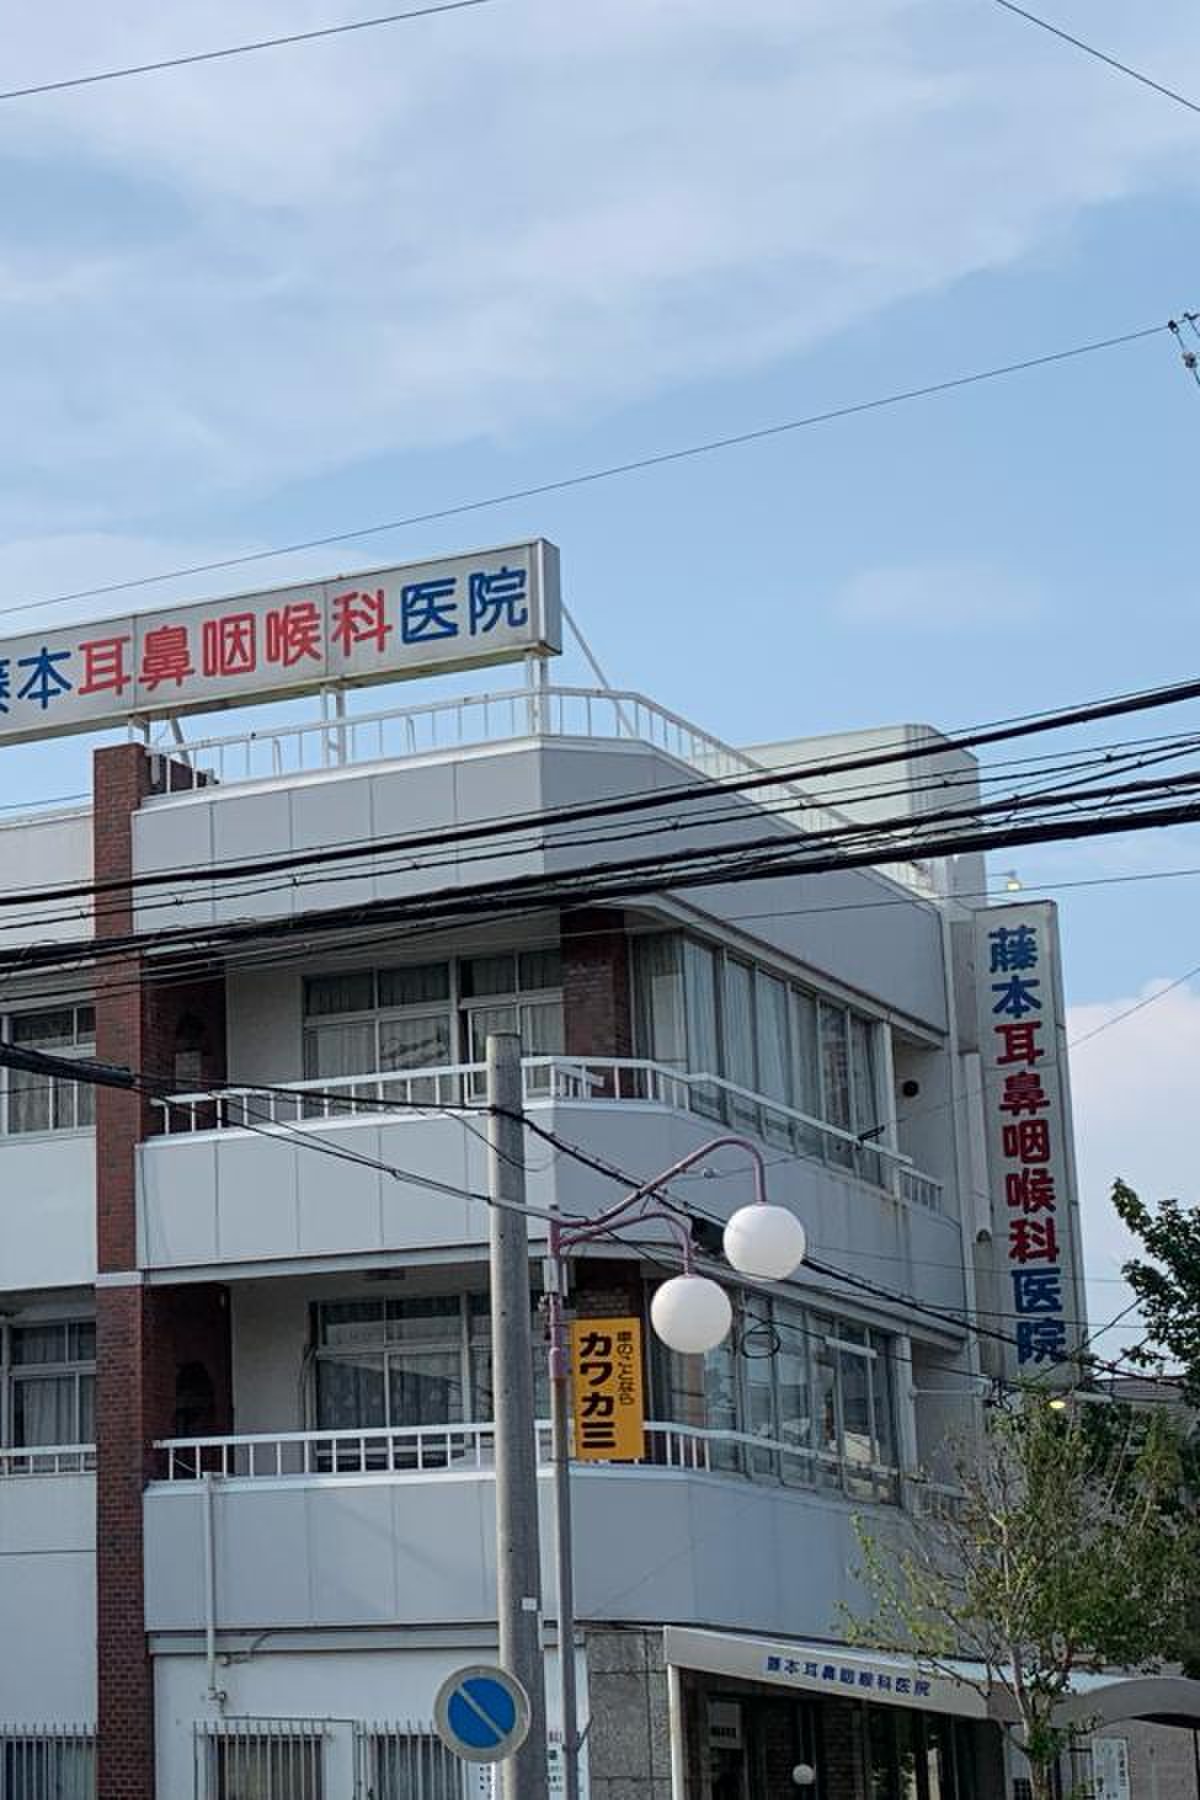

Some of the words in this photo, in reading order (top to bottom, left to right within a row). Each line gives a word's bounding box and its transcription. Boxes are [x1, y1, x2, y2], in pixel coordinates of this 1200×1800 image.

[987, 924, 1067, 1366] 藤本耳鼻咽喉科医院
[579, 1331, 616, 1448] カワカミ
